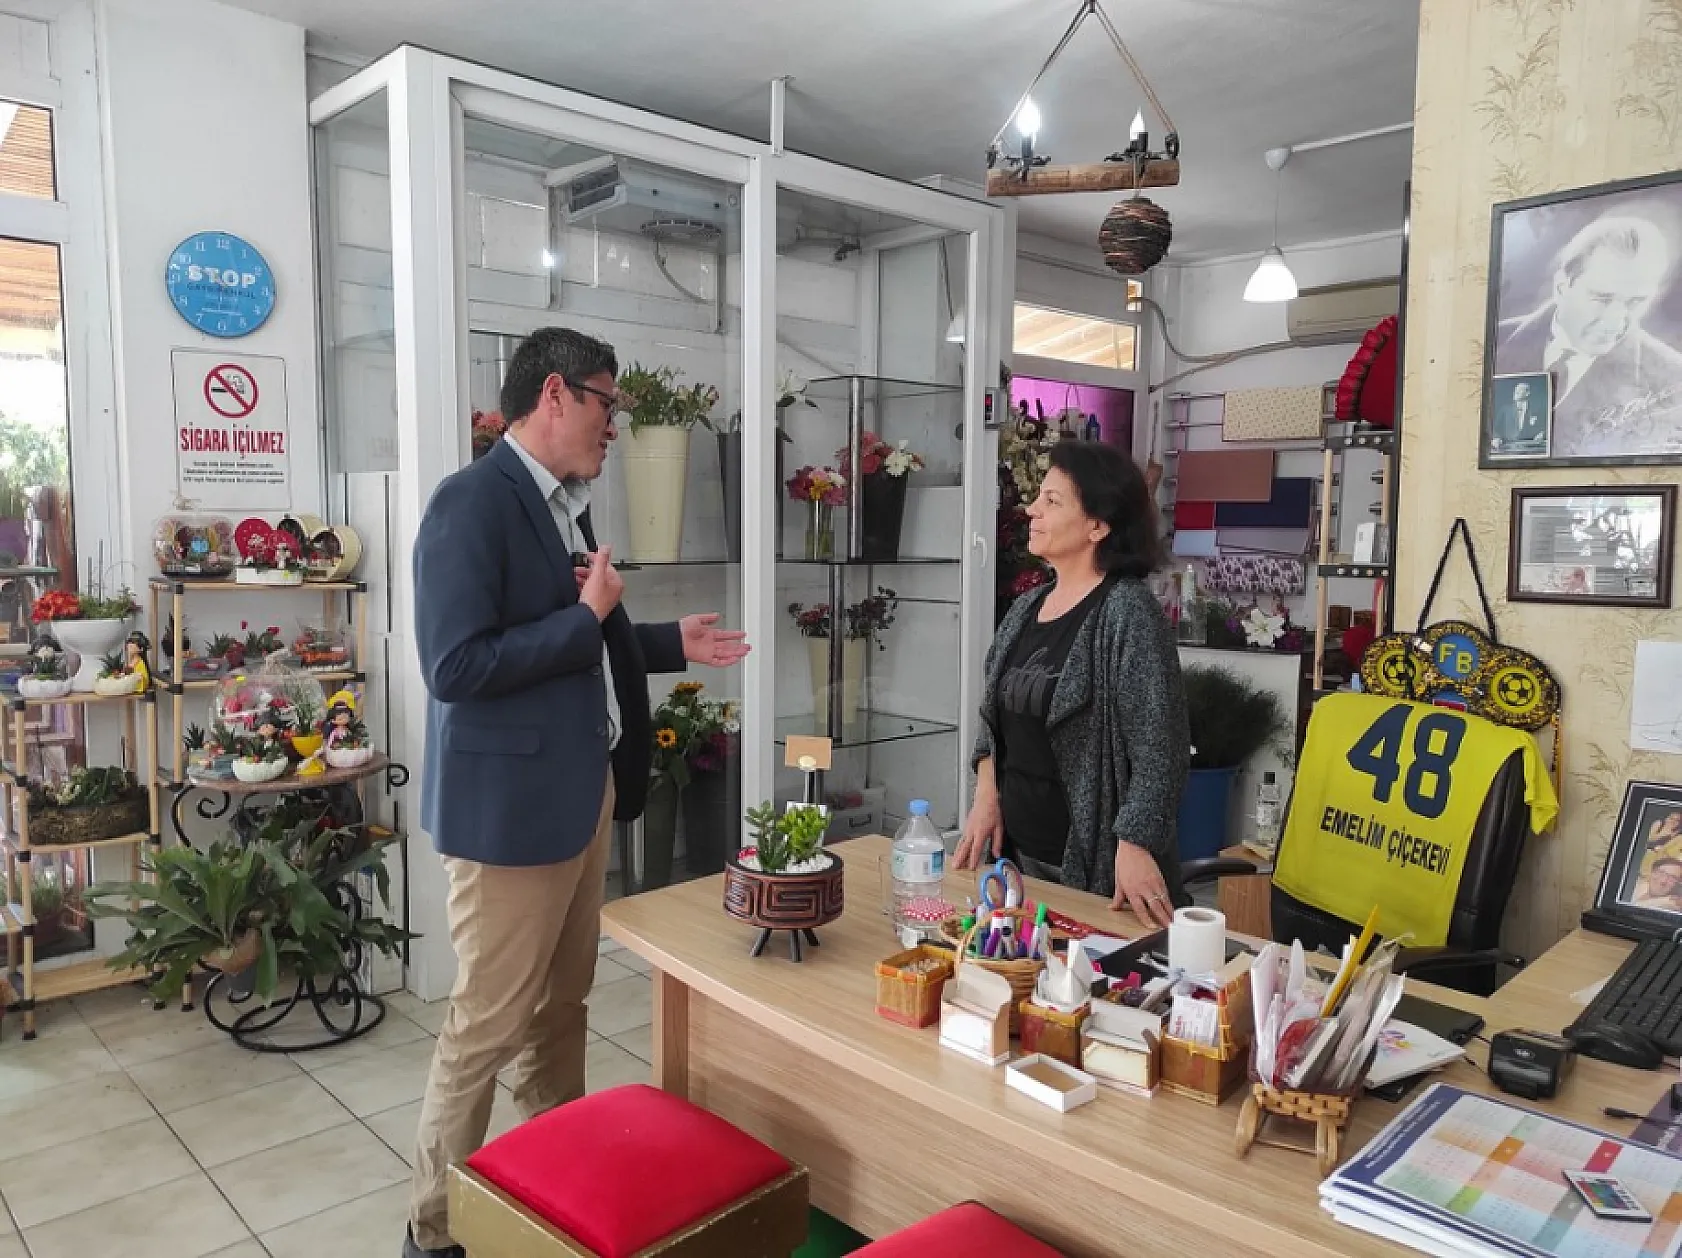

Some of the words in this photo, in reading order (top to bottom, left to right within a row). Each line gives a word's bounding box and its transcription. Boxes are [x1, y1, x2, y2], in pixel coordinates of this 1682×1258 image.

[186, 264, 256, 288] STOP
[180, 421, 230, 452] SİGARA
[232, 423, 285, 460] İÇİLMEZ
[1439, 642, 1473, 674] FB
[1346, 702, 1467, 819] 48
[1320, 806, 1386, 850] EMELİM
[1387, 825, 1452, 876] ÇİÇEKEVİ
